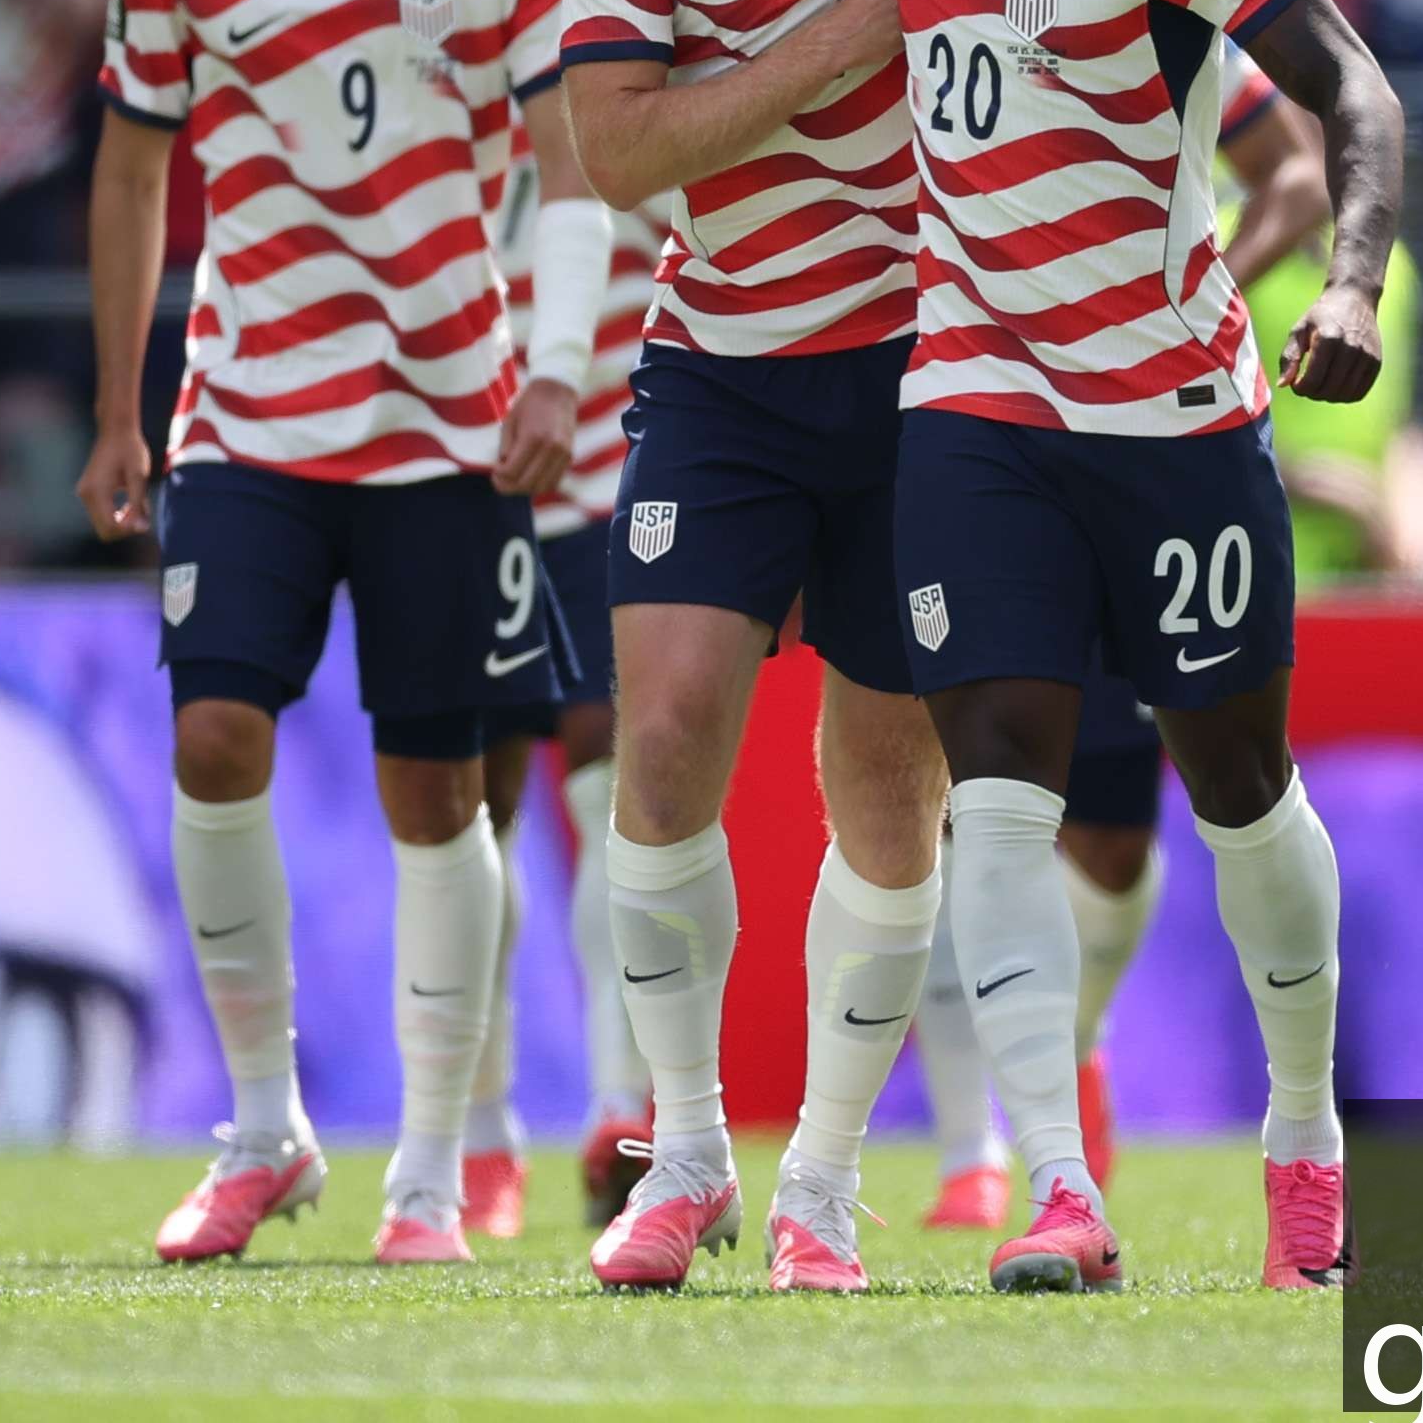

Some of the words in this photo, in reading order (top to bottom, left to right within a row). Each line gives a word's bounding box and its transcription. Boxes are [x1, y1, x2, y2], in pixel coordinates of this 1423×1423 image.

[340, 61, 376, 153] 9
[928, 33, 1002, 140] 20
[634, 505, 673, 527] USA
[496, 537, 535, 640] 9
[911, 588, 941, 614] USA
[1154, 524, 1252, 634] 20
